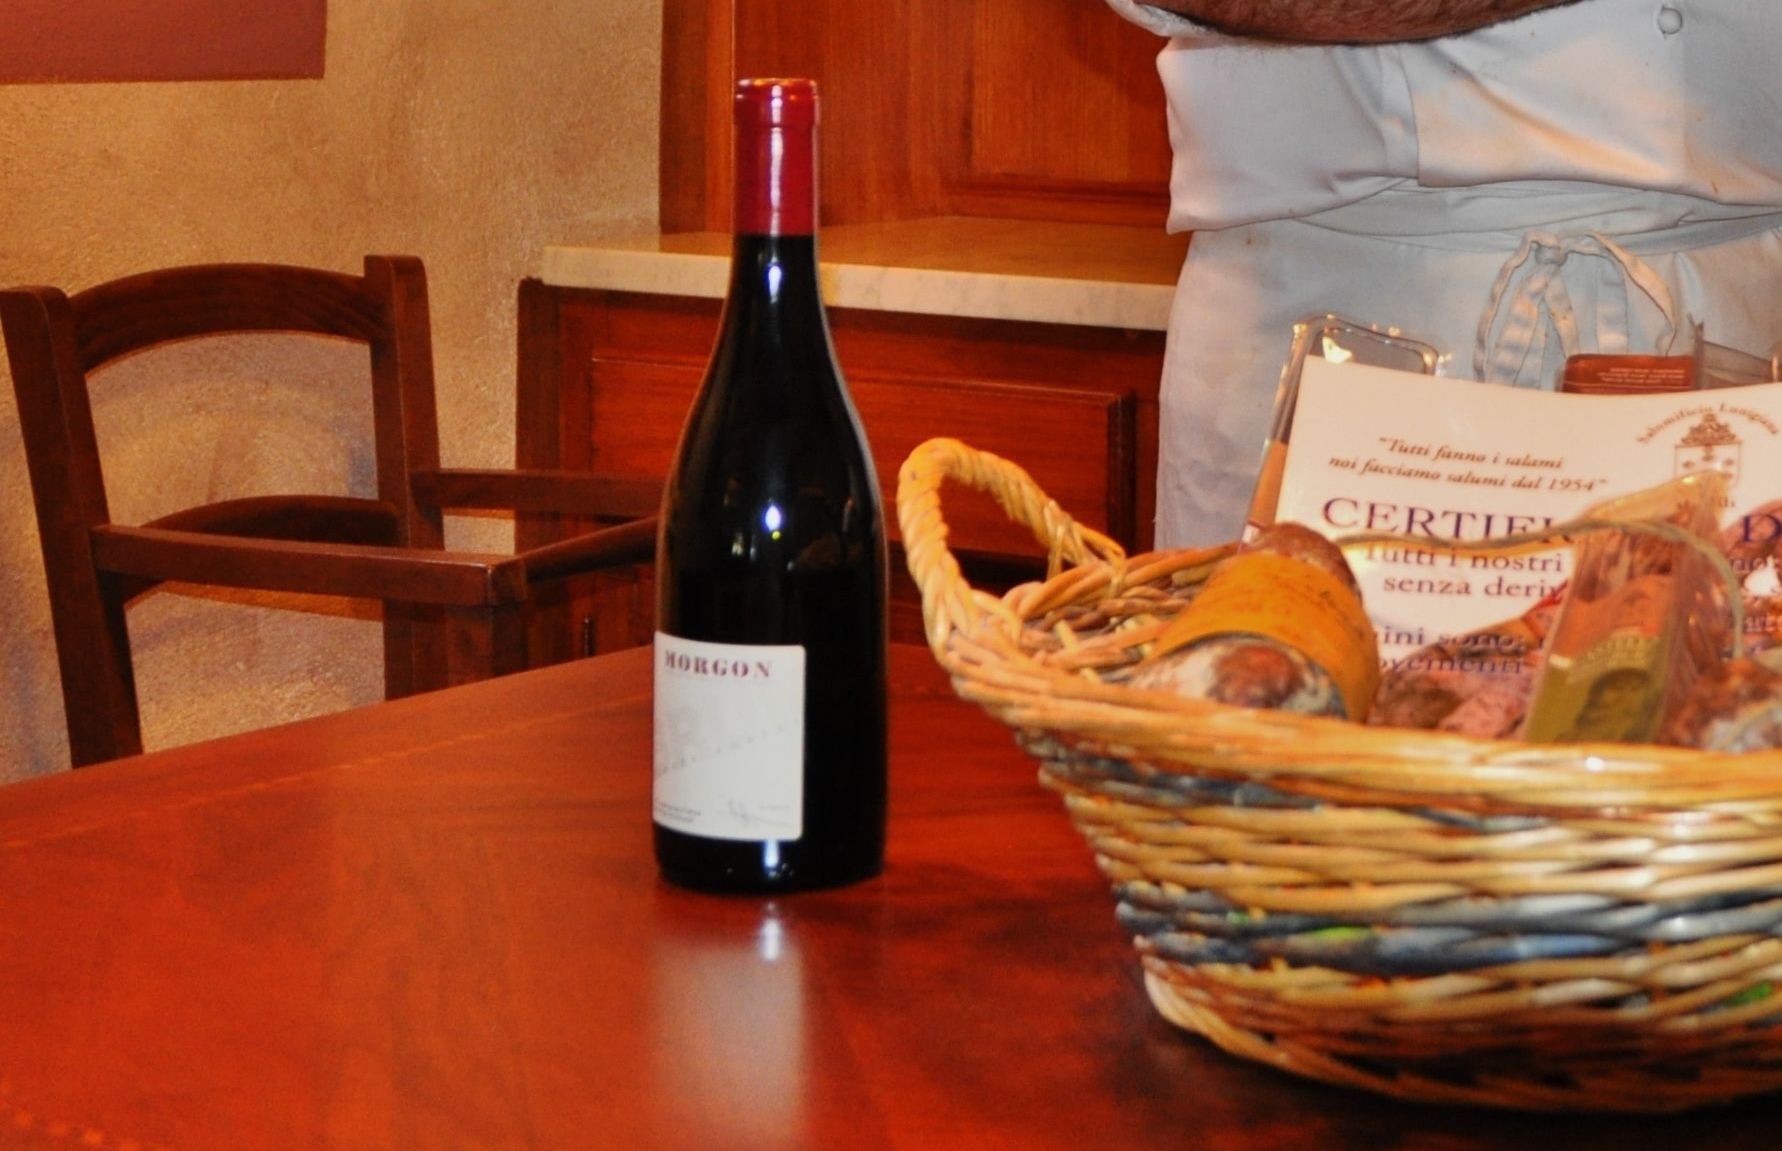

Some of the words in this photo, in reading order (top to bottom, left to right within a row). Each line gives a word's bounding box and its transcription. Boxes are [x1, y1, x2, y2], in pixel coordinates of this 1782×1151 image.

[1432, 443, 1486, 464] fanno
[1492, 451, 1500, 464] i
[1504, 454, 1564, 469] salami
[1328, 455, 1356, 470] noi
[1359, 458, 1441, 481] facciamo
[1446, 470, 1506, 488] salumi
[1512, 475, 1541, 490] dal
[1321, 496, 1576, 545] CERTIFI
[1365, 545, 1436, 567] Tutti
[1470, 551, 1564, 573] nostri
[1383, 577, 1472, 596] senza
[1484, 576, 1562, 598] deriv
[1374, 626, 1424, 646] ini
[664, 650, 773, 679] MORGON
